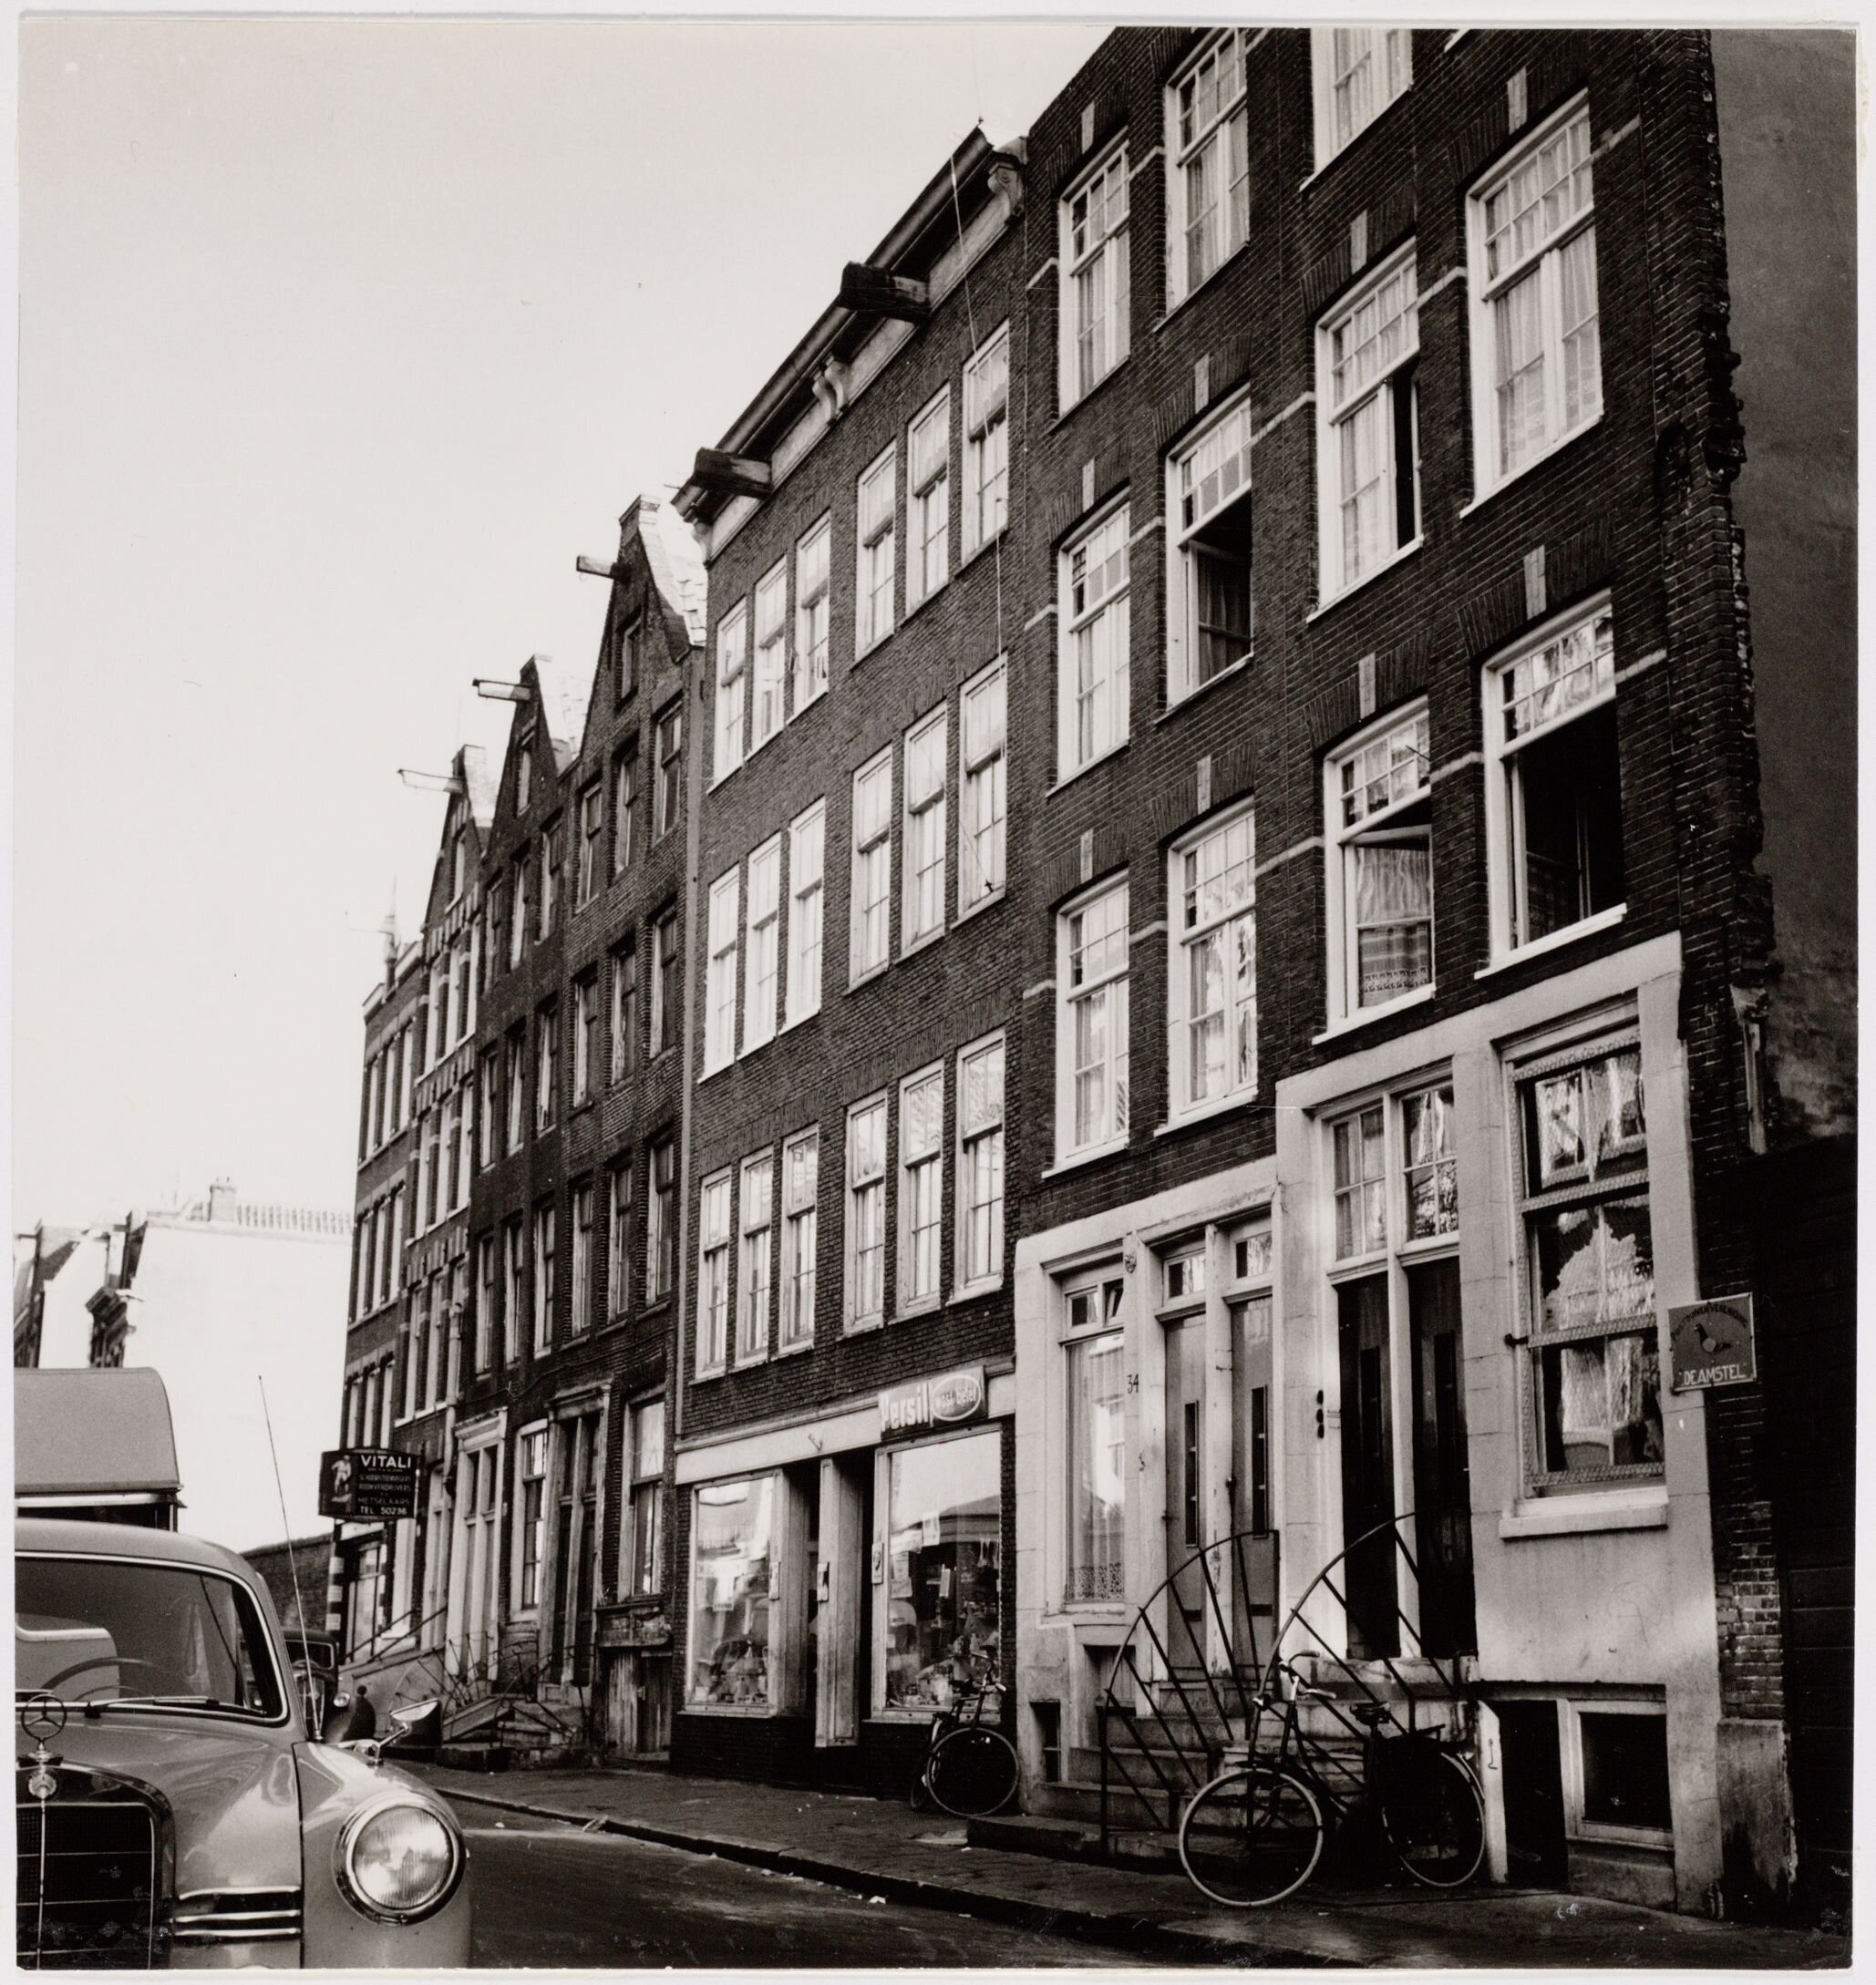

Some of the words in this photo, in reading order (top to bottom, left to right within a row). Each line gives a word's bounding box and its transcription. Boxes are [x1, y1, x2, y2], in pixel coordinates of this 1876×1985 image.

[1127, 1373, 1139, 1394] 34
[1684, 1369, 1697, 1385] DE
[1697, 1363, 1747, 1383] AMSTEL
[879, 1383, 929, 1432] Persil
[360, 1455, 412, 1468] VITALI
